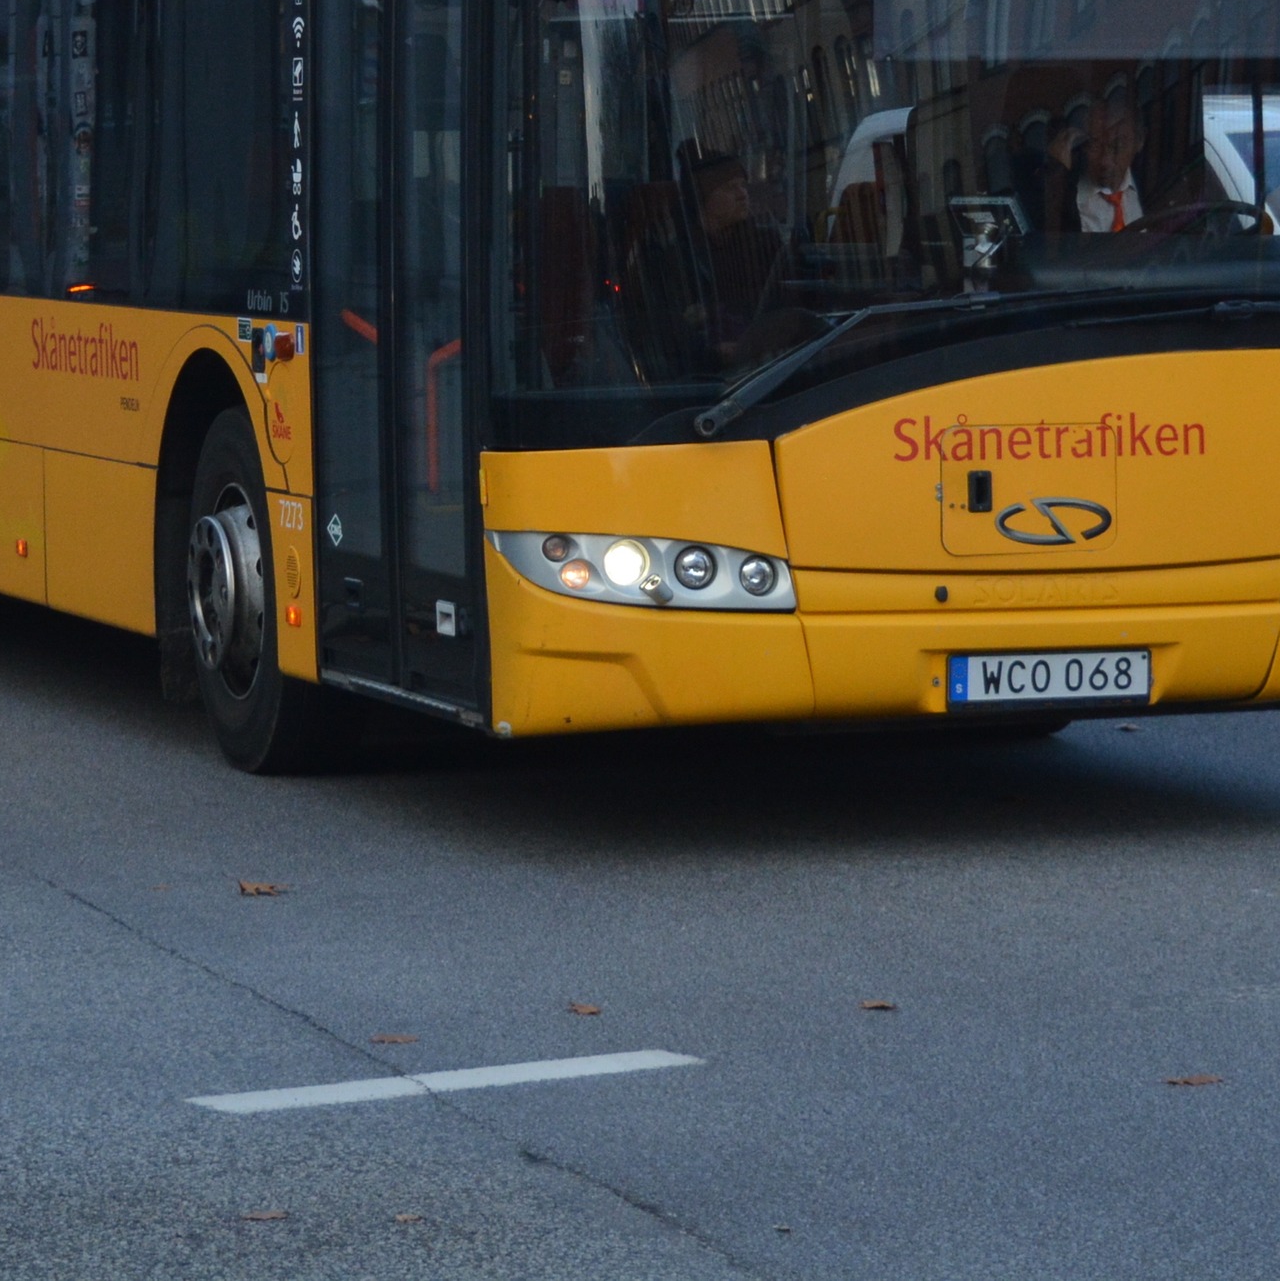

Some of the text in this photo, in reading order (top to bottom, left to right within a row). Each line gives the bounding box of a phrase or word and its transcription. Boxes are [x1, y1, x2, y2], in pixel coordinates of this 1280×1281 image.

[280, 291, 289, 314] 15
[31, 316, 140, 381] Skånetrafiken
[893, 412, 1206, 462] Skånetrafiken
[279, 499, 304, 531] 7273
[972, 575, 1121, 606] SOLARIS
[981, 659, 1051, 695] WCO
[1064, 657, 1132, 692] 068
